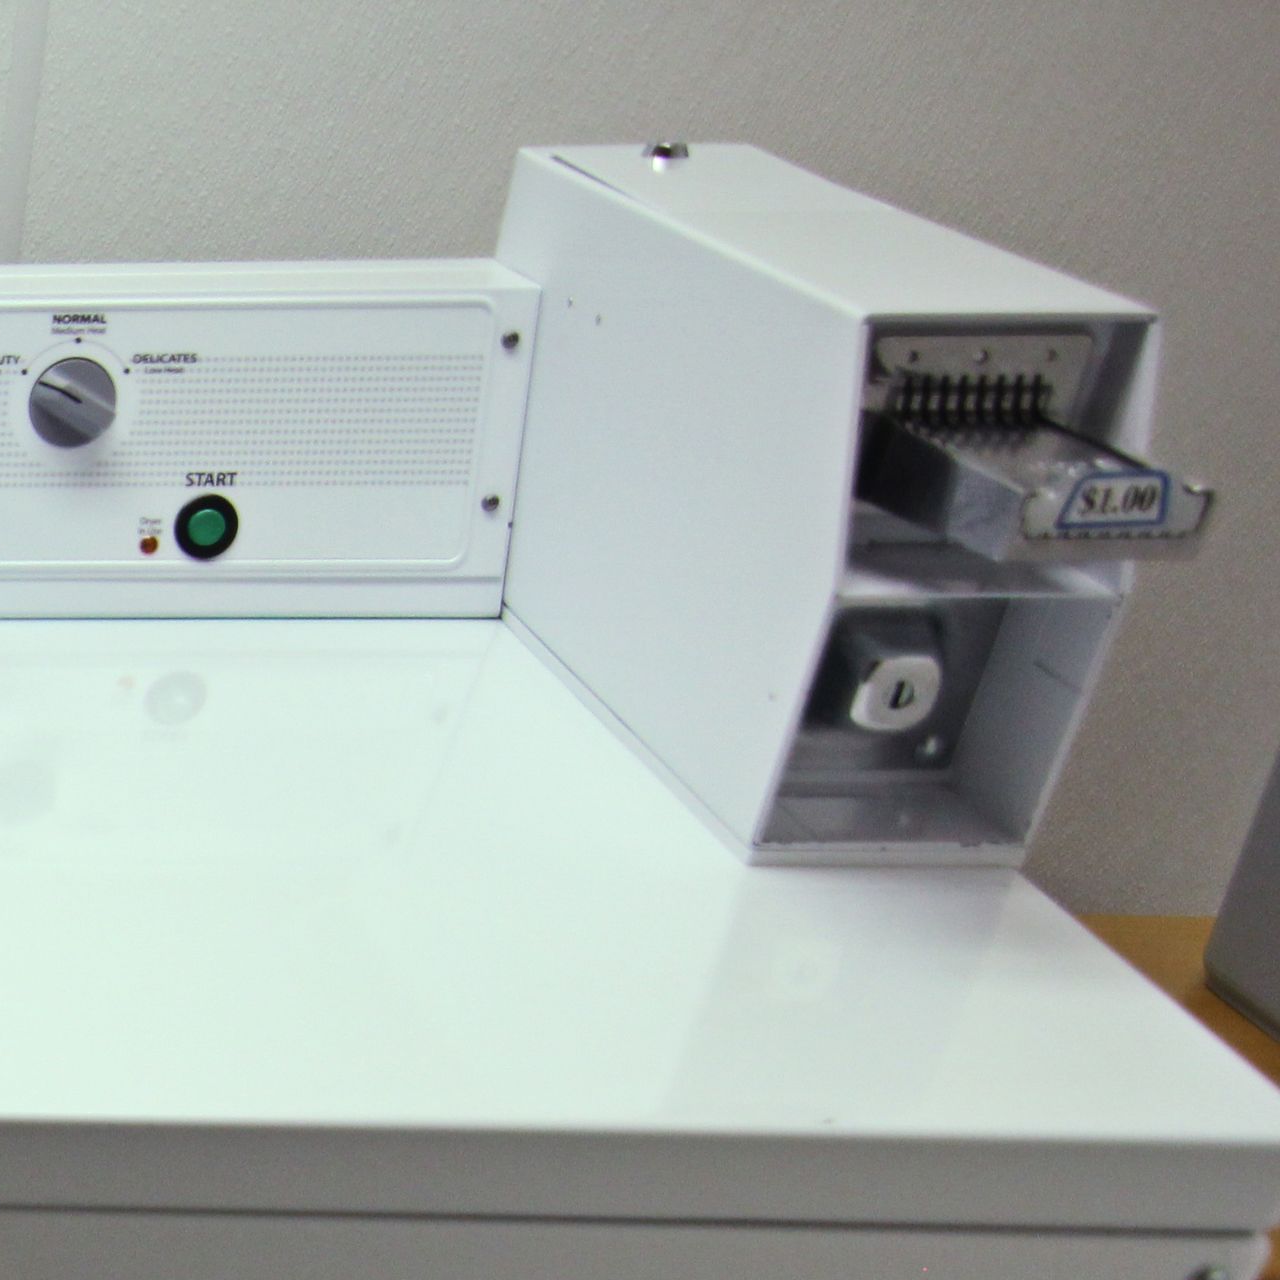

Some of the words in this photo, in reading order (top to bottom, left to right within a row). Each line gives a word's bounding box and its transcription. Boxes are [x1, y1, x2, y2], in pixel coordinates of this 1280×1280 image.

[52, 314, 107, 325] NORMAL
[132, 354, 198, 365] DELICATES
[184, 472, 238, 488] START
[1079, 484, 1157, 514] $1.00
